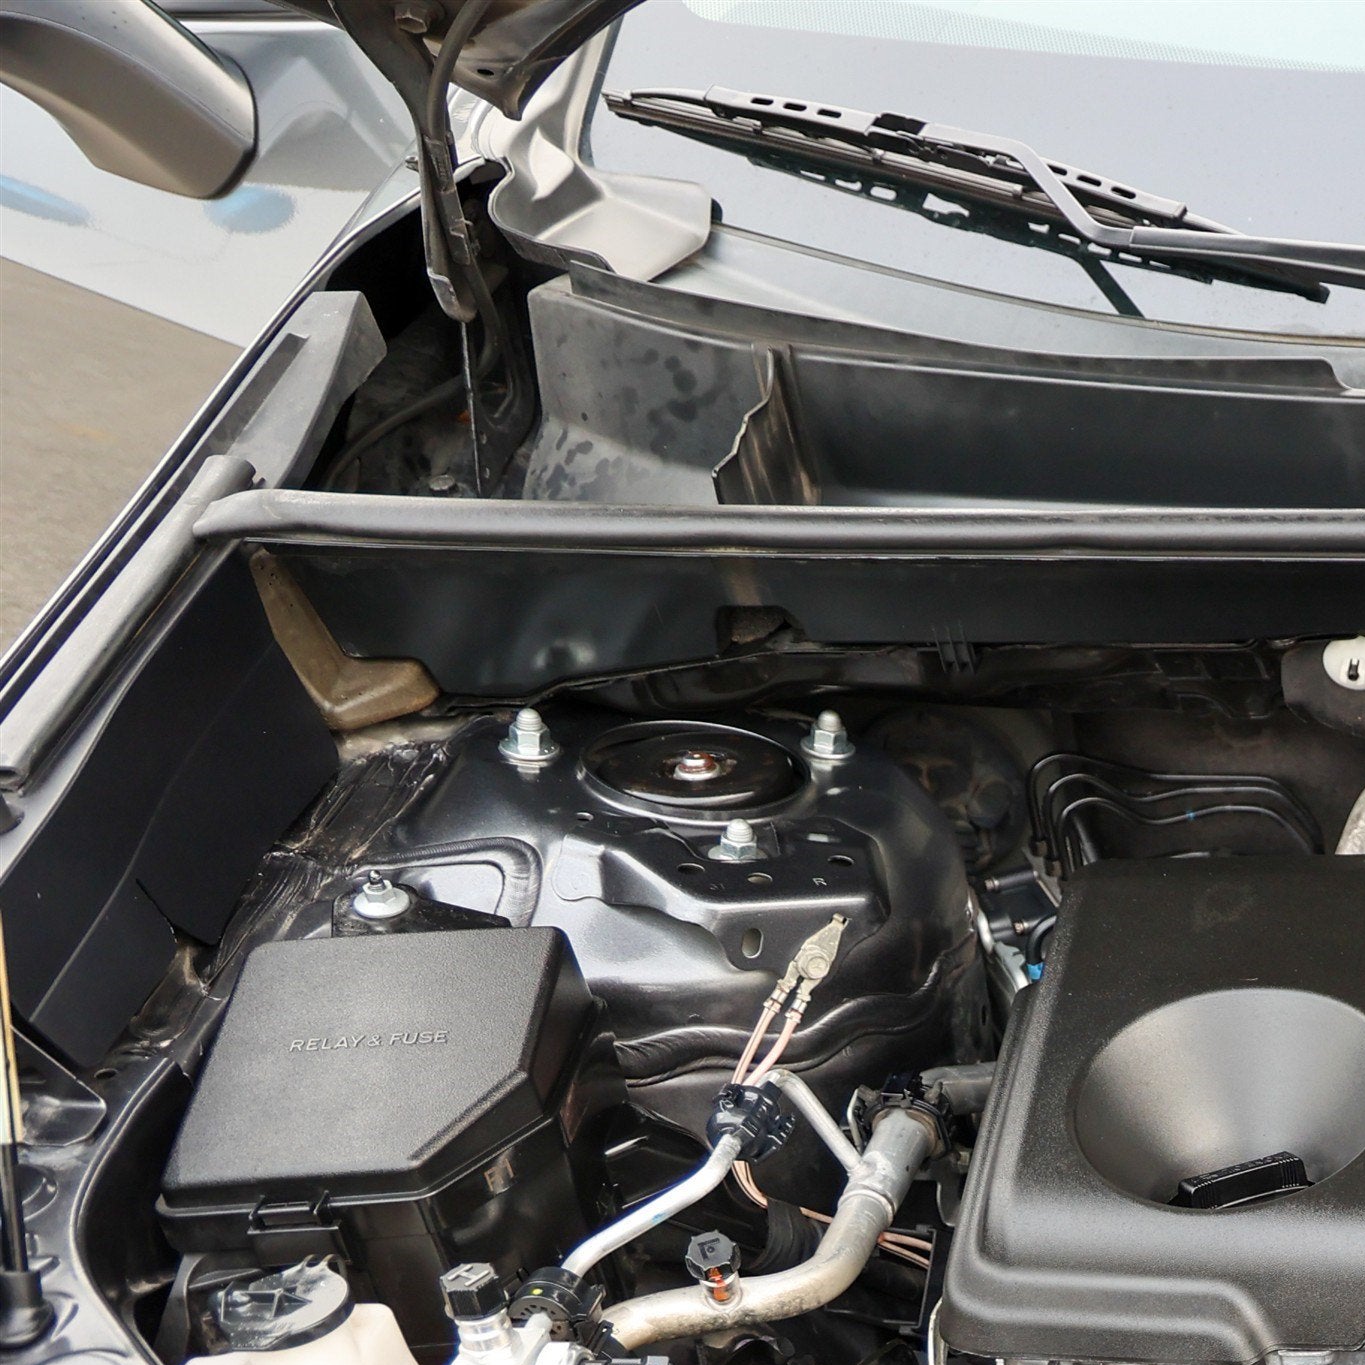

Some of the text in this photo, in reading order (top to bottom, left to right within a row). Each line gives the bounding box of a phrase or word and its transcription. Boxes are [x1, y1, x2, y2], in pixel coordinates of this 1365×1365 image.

[289, 1030, 448, 1052] RELAY & FUSE
[447, 1264, 491, 1287] H
